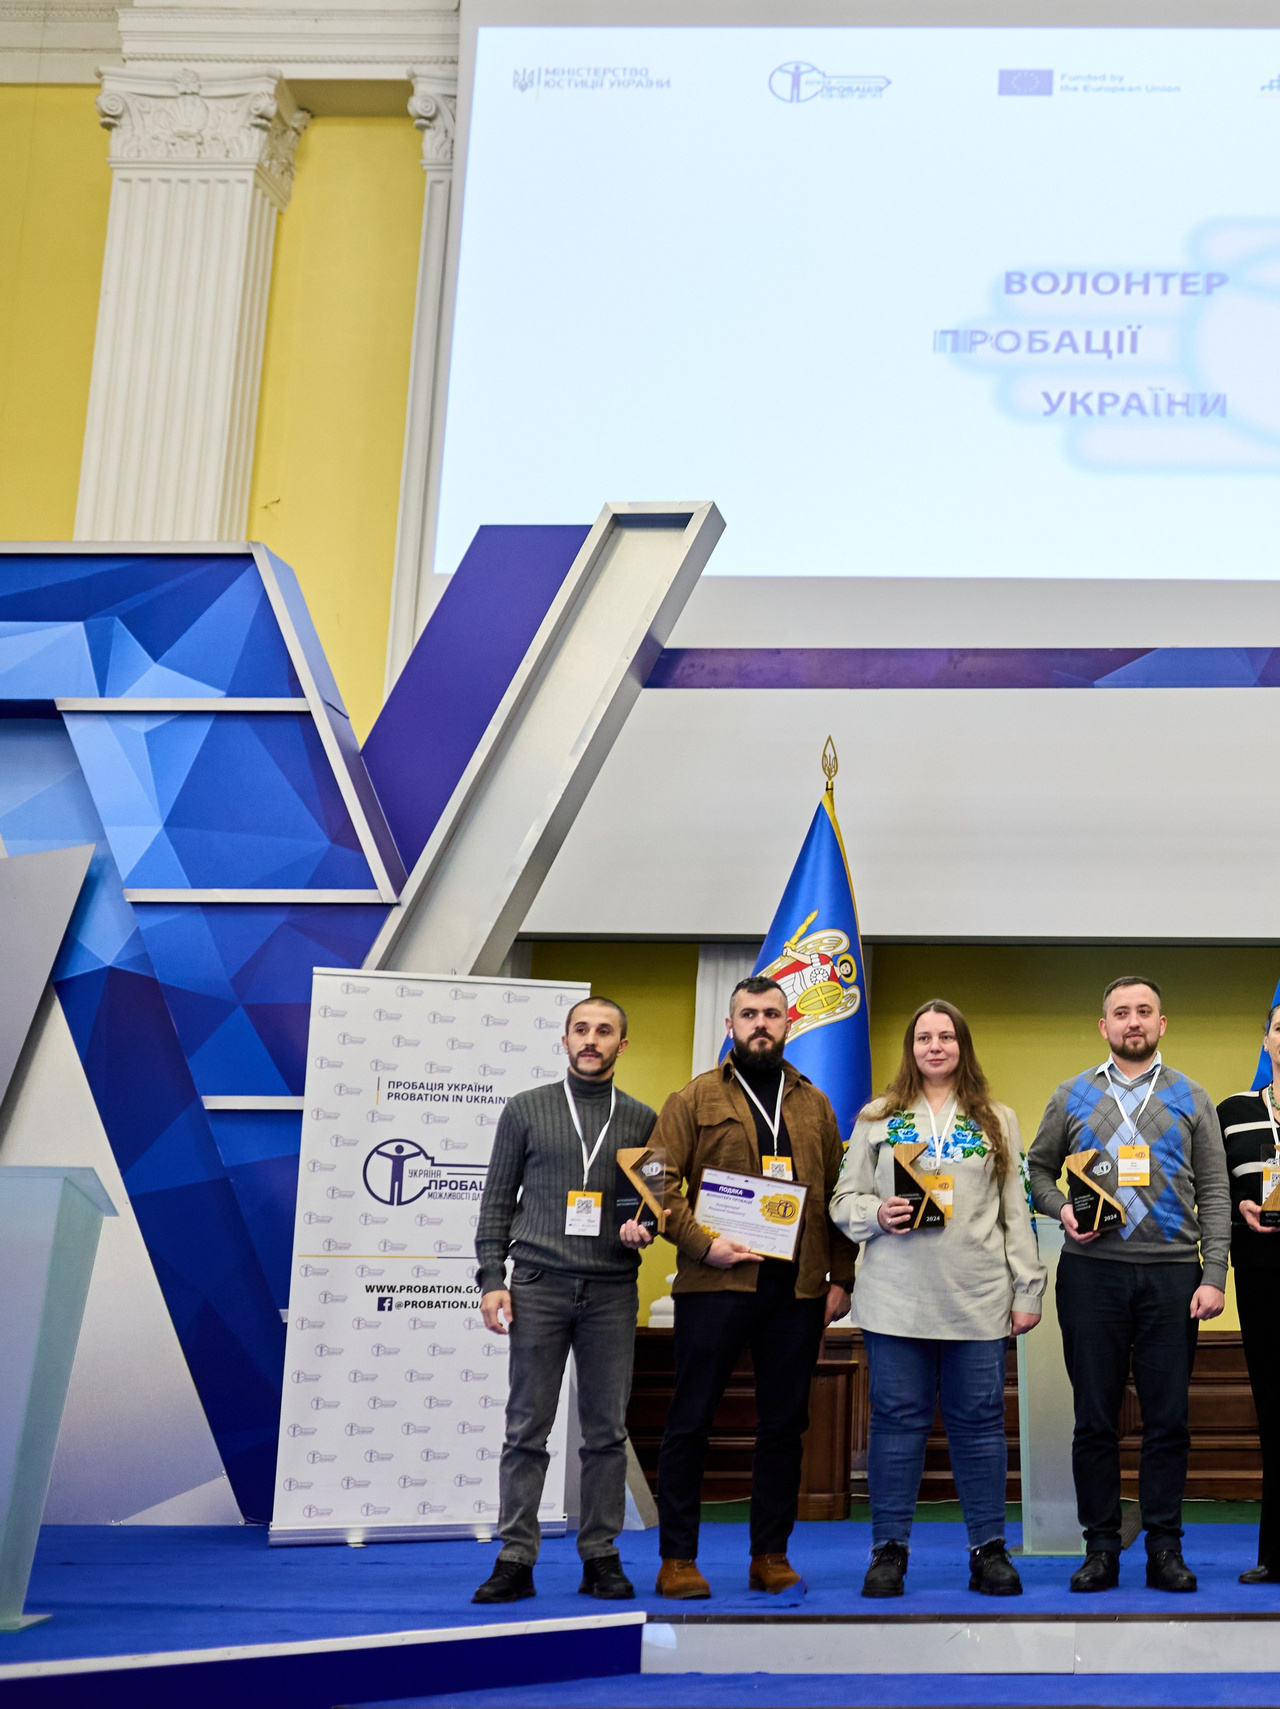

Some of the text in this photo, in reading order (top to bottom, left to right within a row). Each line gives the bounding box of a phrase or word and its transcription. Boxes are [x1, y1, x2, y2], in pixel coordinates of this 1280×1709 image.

[544, 66, 649, 77] МІНІСТЕРСТВО
[609, 78, 671, 89] УКРАЇНИ
[1060, 73, 1125, 83] Funded by
[1060, 84, 1181, 95] the European Union
[1004, 270, 1229, 296] ВОЛОНТЕР
[933, 324, 1142, 360] ПРОБАЦІЇ
[1041, 386, 1228, 417] УКРАЇНИ
[388, 1080, 494, 1093] ПРОБАЦІЯ УКРАЇНИ
[387, 1092, 449, 1103] PROBATION
[451, 1094, 463, 1103] IN
[408, 1168, 442, 1179] УКРАЇНА
[718, 1185, 744, 1196] ПОДЯКА
[427, 1191, 483, 1202] МОЖЛИВОСТІ ДЛ
[1103, 1213, 1118, 1222] 2024
[365, 1284, 482, 1294] WWW.PROBATION.GO
